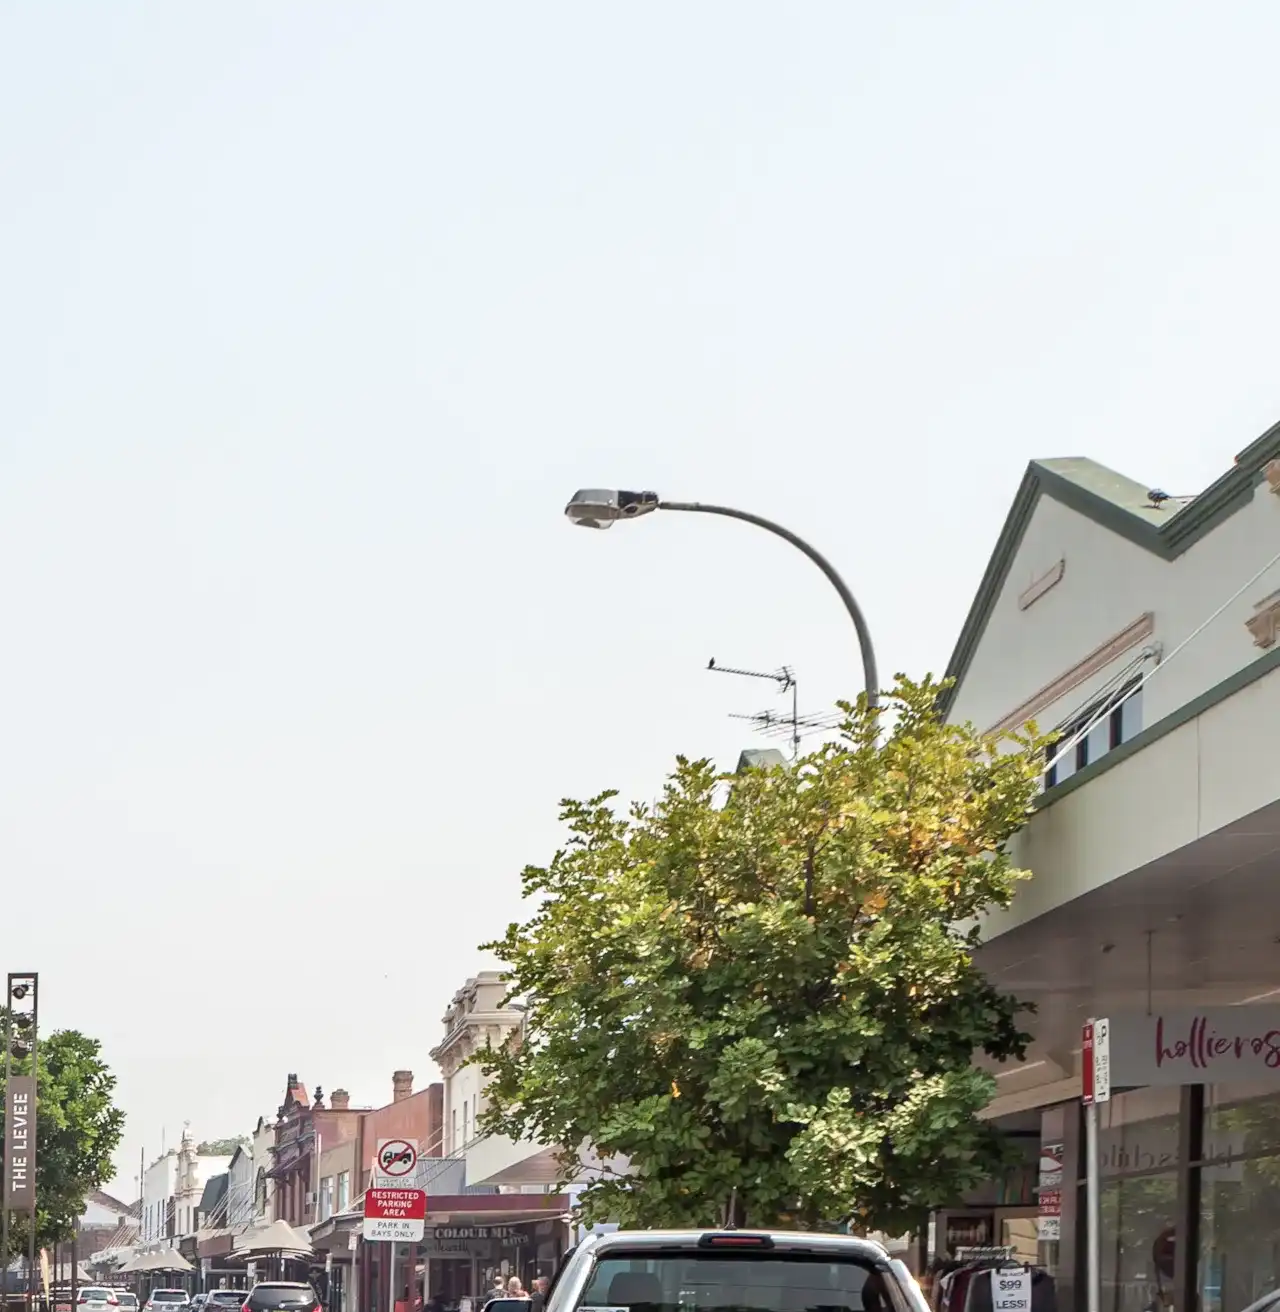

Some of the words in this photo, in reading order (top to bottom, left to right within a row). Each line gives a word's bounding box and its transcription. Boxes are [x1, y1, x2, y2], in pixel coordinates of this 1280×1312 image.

[13, 1093, 28, 1150] LEVEE
[12, 1156, 27, 1192] THE
[371, 1191, 420, 1200] RESTRICTED
[377, 1200, 413, 1209] PARKING
[383, 1209, 406, 1217] AREA
[435, 1227, 488, 1239] COLOUR
[999, 1279, 1022, 1290] $99
[996, 1299, 1027, 1309] LESS!
